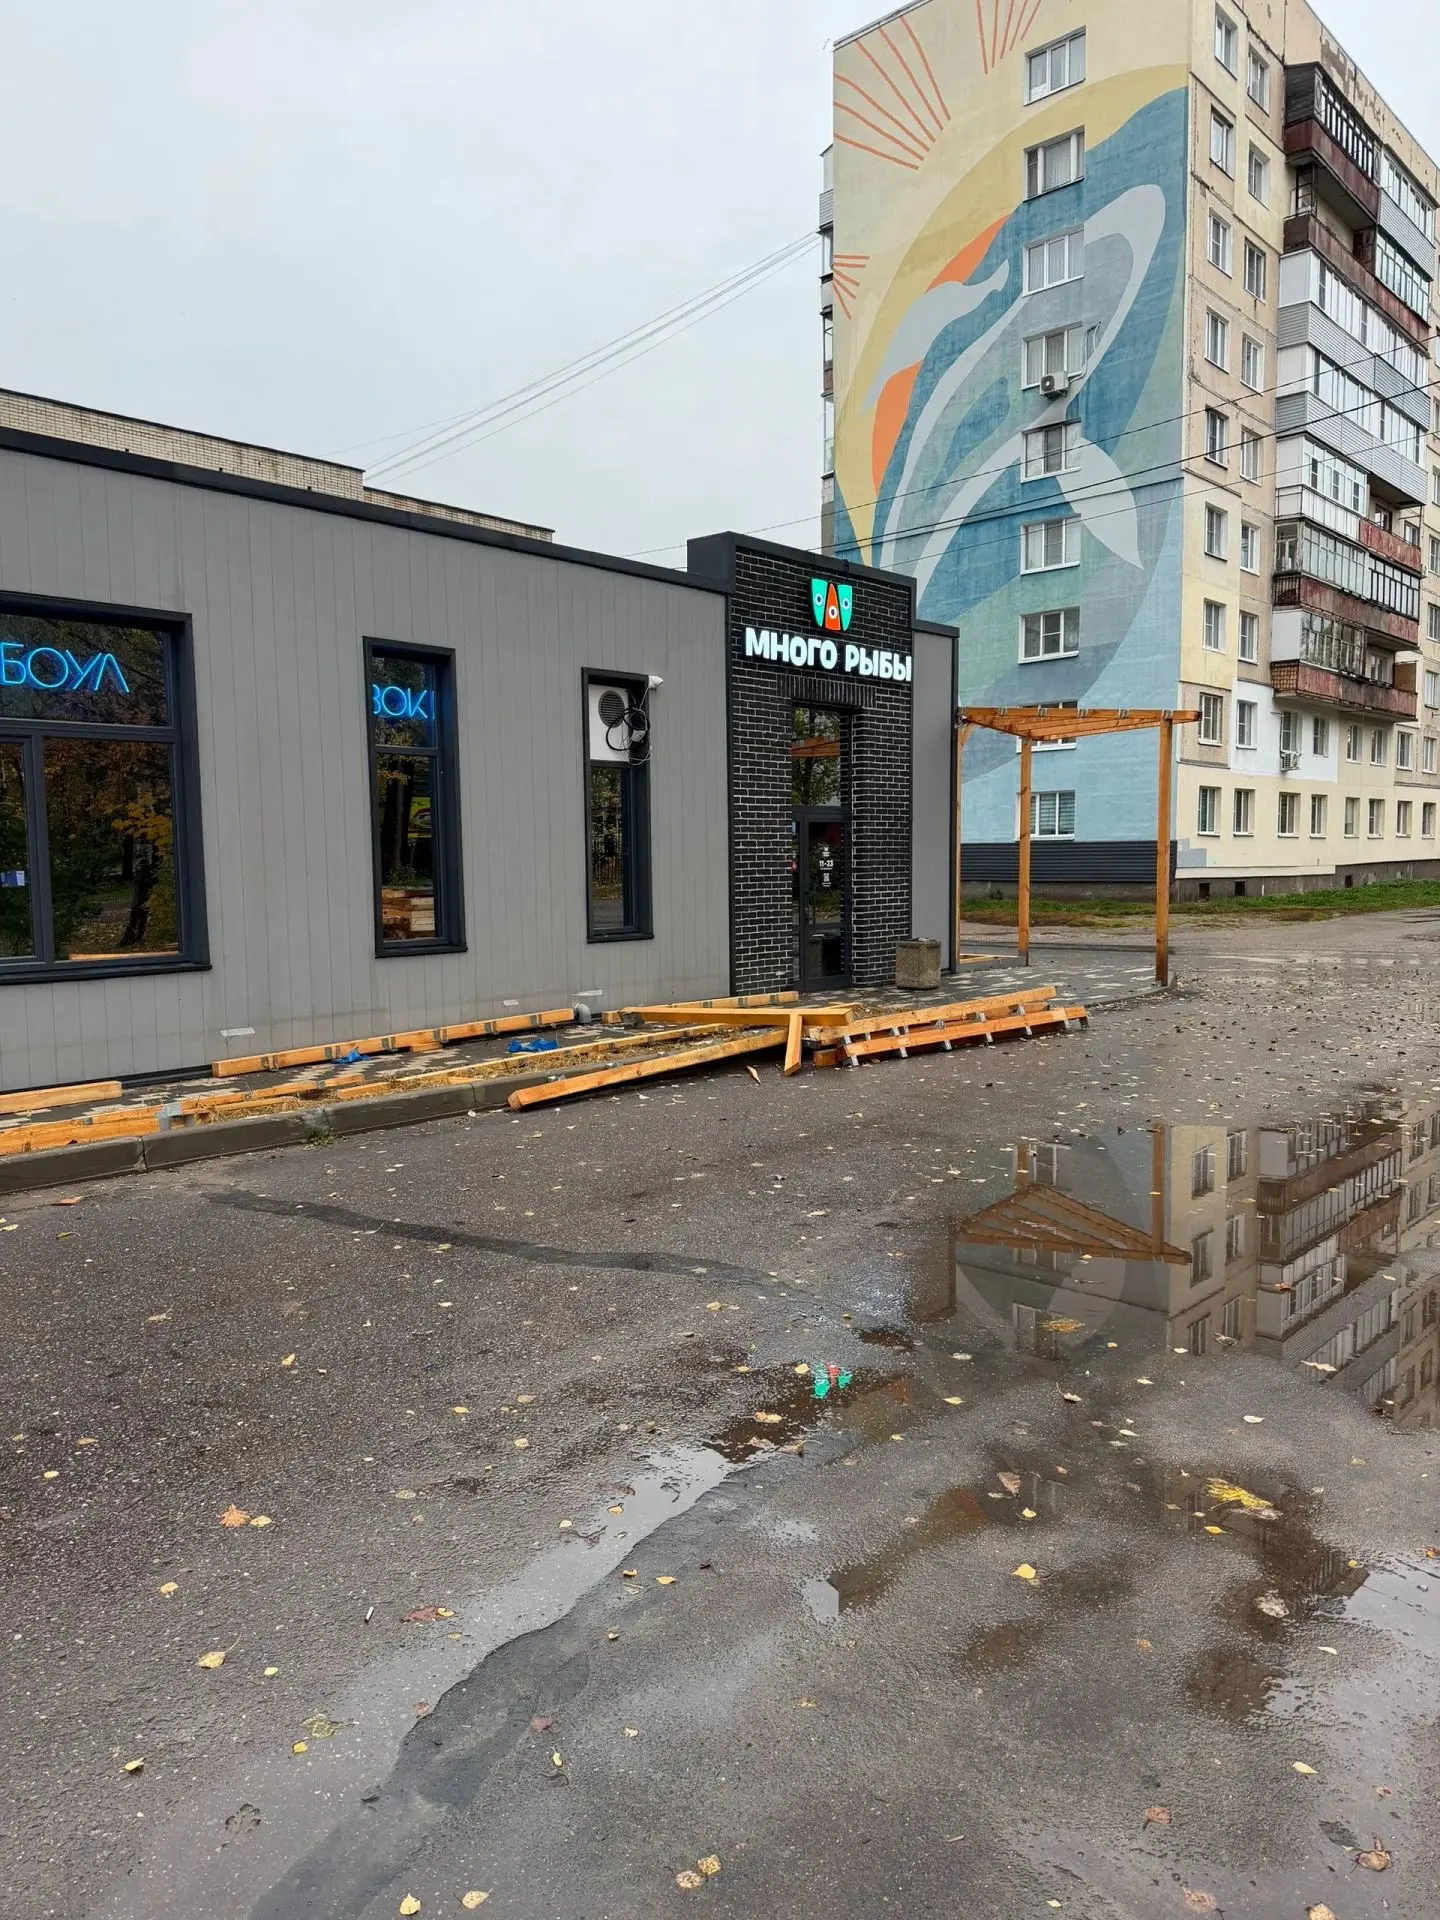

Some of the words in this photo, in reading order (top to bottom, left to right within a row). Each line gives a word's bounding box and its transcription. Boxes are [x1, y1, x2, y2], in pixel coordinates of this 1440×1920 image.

[0, 642, 130, 692] БОУЛ
[745, 627, 838, 670] МНОГО
[844, 644, 913, 682] РЫБЫ
